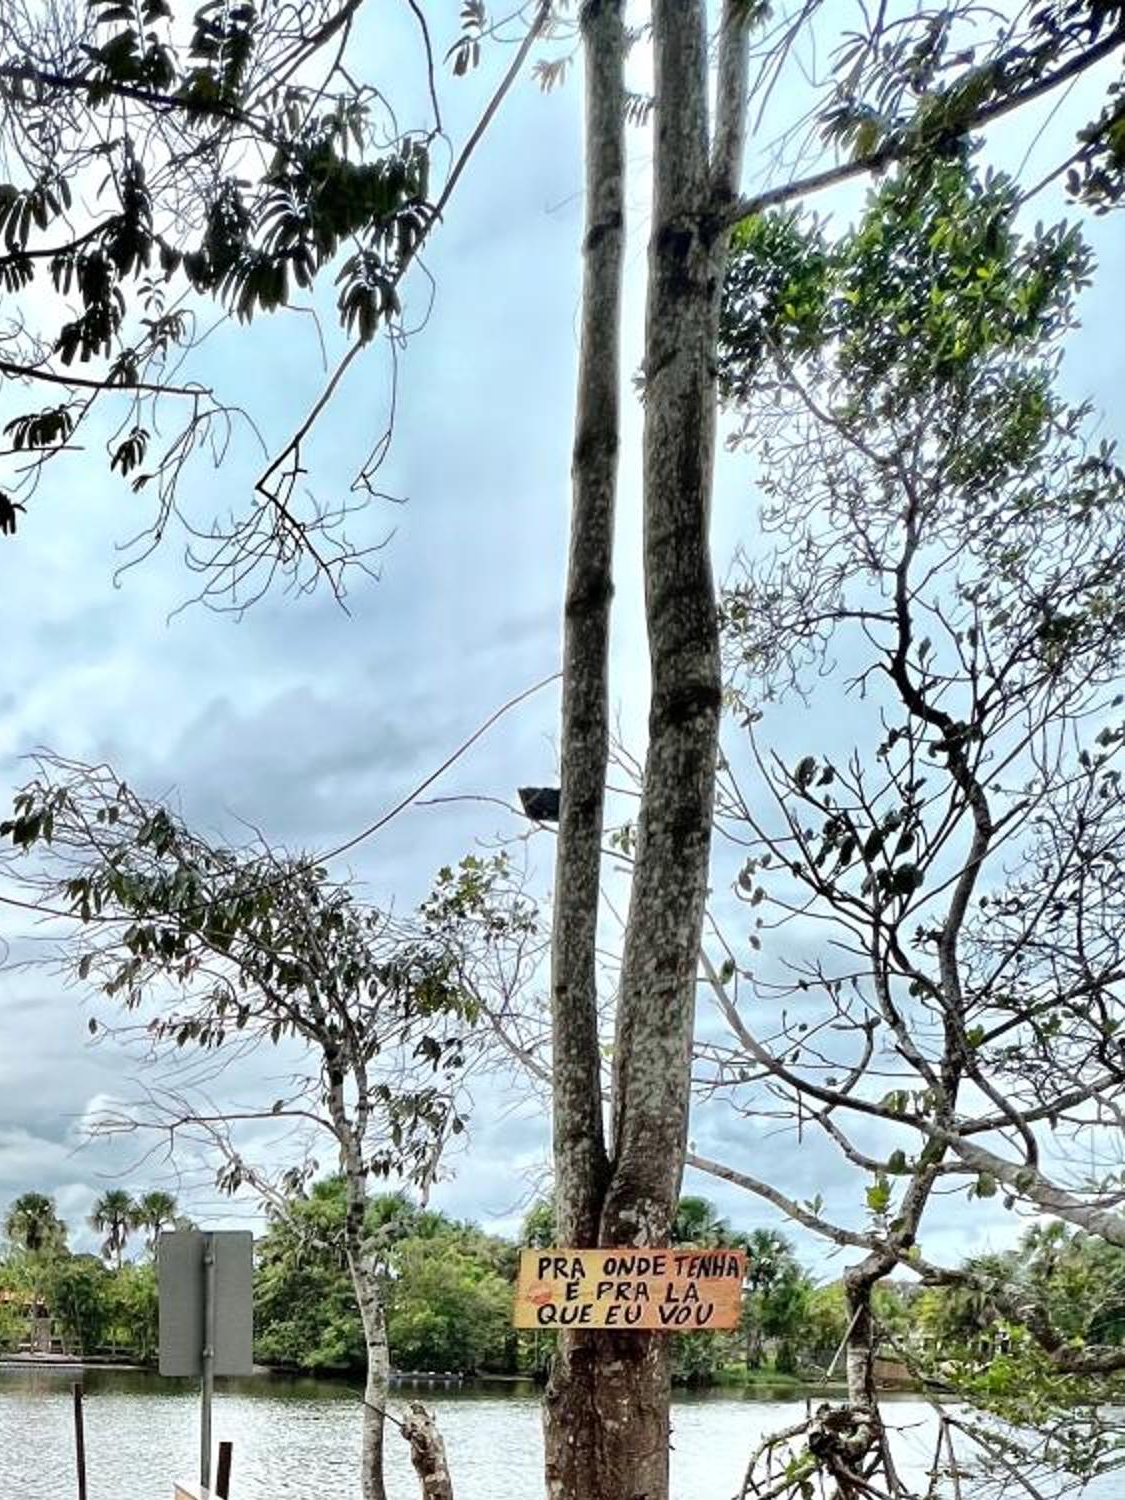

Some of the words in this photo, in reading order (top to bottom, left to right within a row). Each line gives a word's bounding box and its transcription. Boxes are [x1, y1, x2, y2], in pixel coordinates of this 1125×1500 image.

[538, 1257, 586, 1280] PRA
[603, 1255, 666, 1277] ONDE
[675, 1255, 739, 1278] TENHA
[565, 1279, 580, 1301] É
[597, 1281, 650, 1302] PRA
[665, 1282, 700, 1303] LA
[537, 1303, 594, 1325] QUE
[605, 1304, 642, 1324] EU
[659, 1303, 714, 1326] VOU
